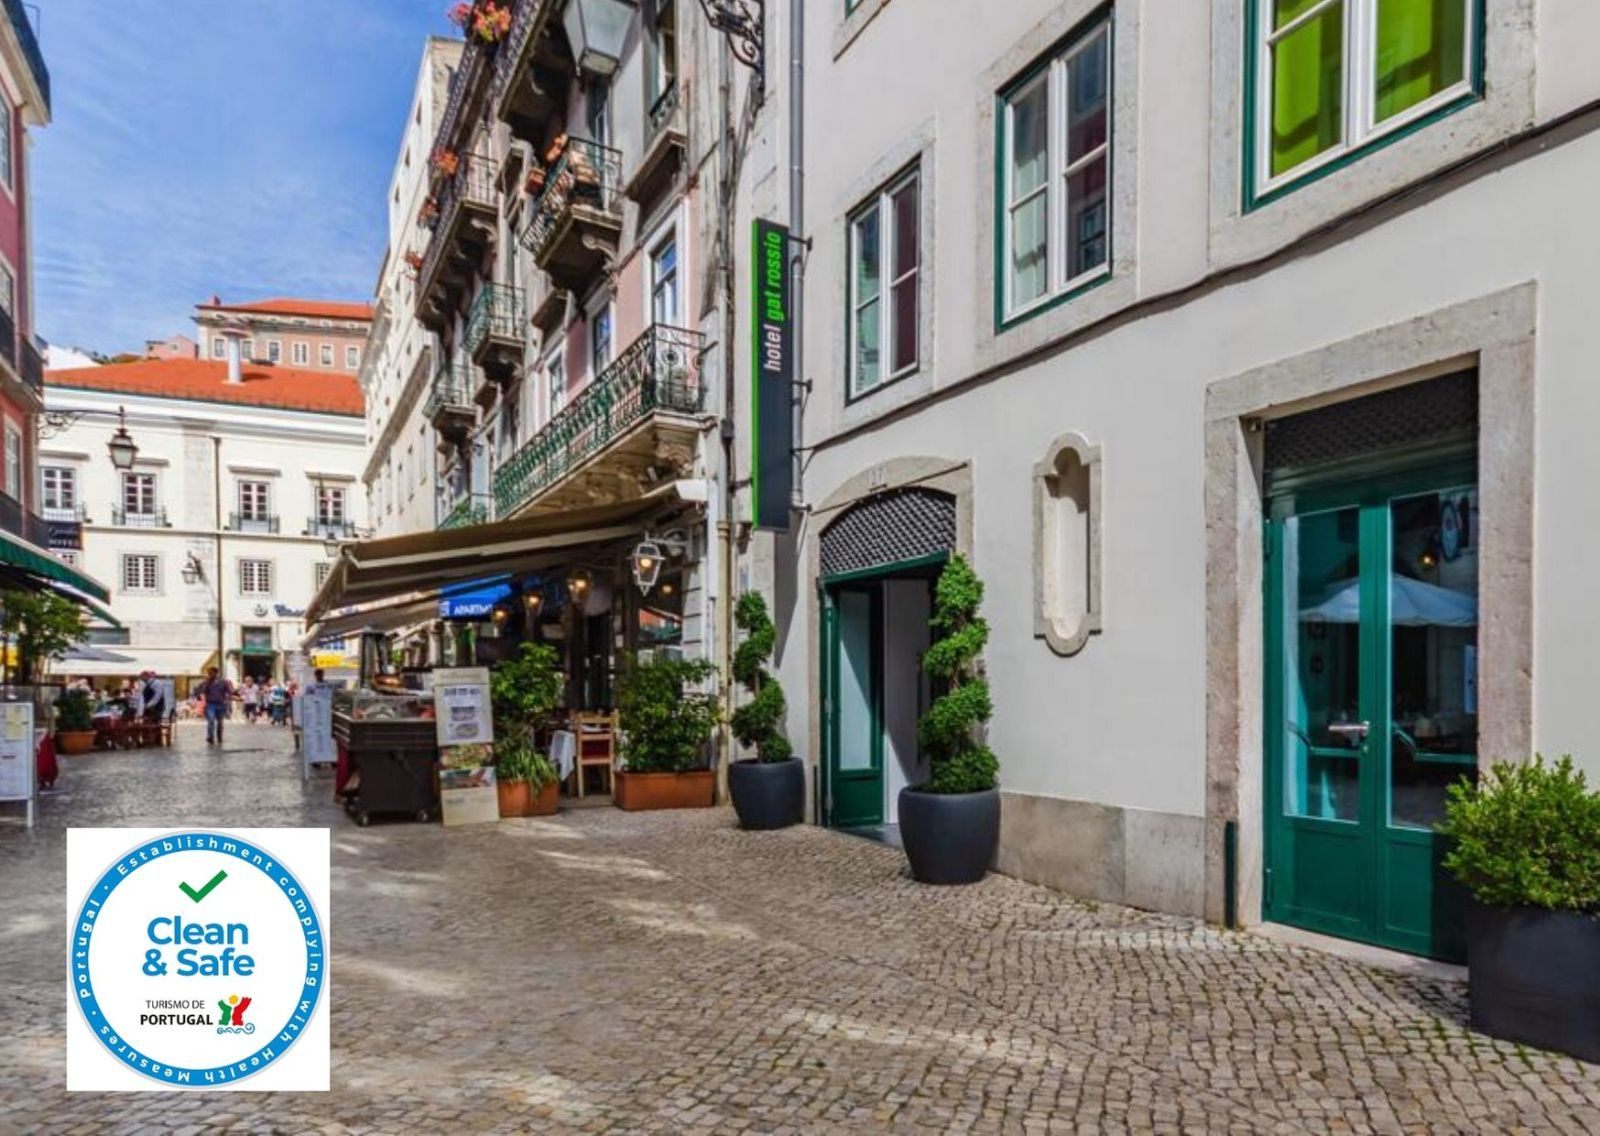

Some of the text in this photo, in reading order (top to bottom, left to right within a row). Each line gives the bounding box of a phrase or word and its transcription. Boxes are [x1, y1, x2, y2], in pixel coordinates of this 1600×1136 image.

[763, 231, 785, 372] hotel gat rossio
